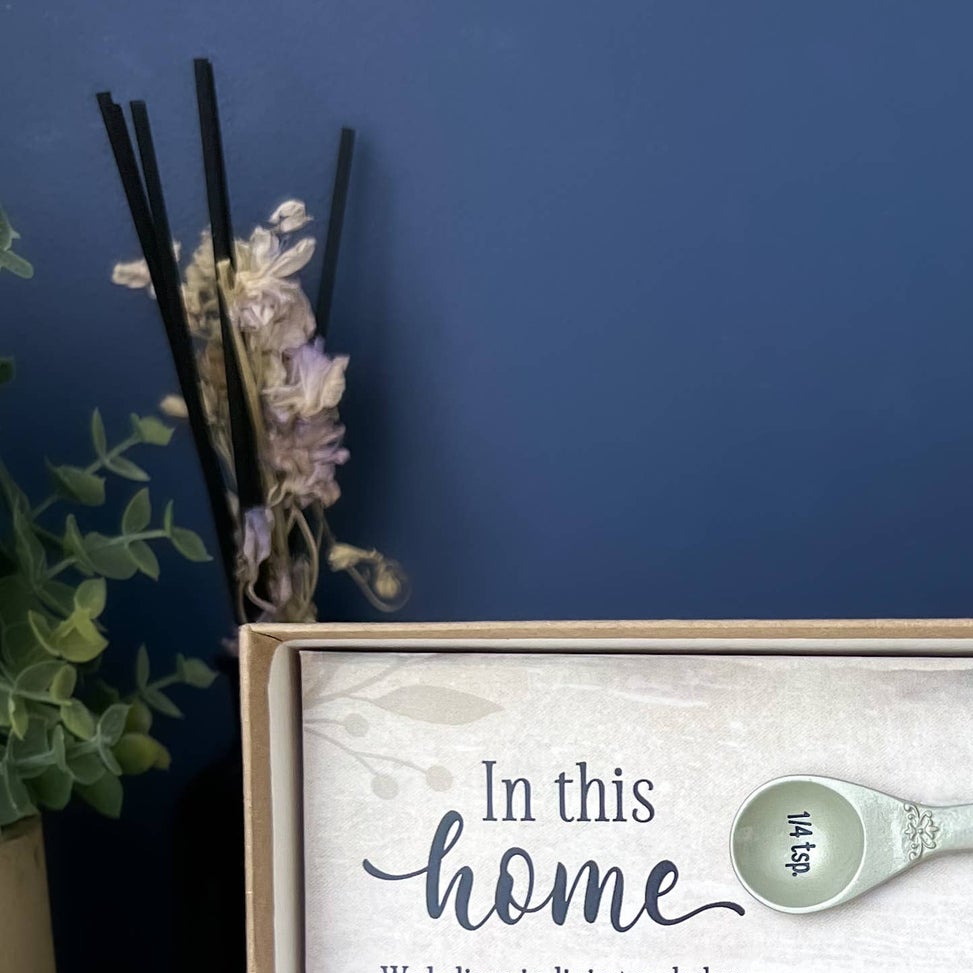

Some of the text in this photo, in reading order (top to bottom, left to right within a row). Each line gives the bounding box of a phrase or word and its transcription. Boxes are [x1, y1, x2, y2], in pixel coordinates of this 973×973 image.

[481, 760, 656, 823] In this
[363, 810, 746, 933] home
[785, 811, 816, 877] 1/4 tsp.
